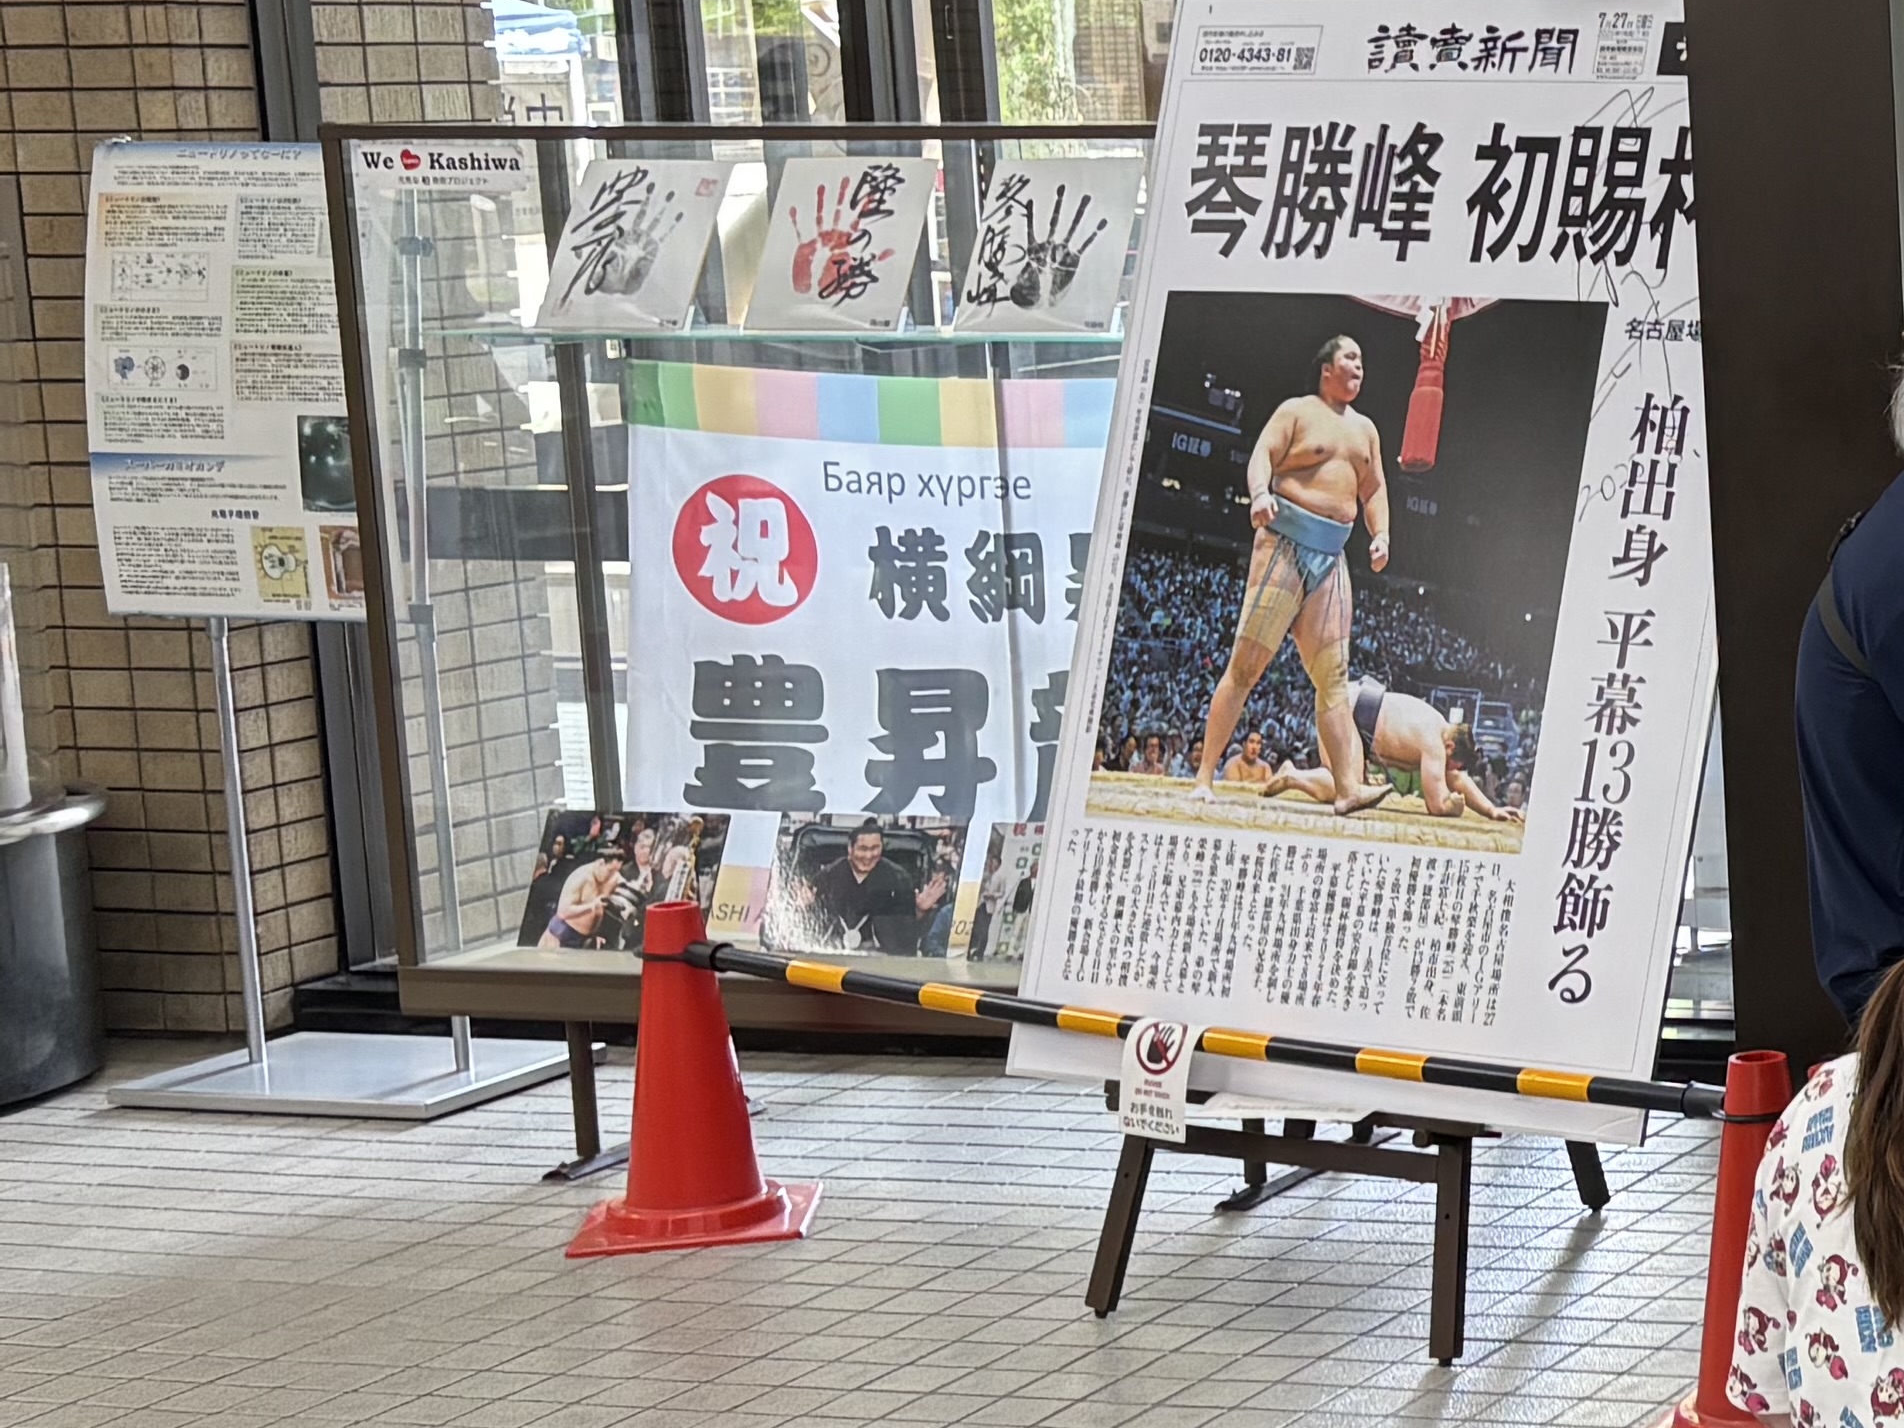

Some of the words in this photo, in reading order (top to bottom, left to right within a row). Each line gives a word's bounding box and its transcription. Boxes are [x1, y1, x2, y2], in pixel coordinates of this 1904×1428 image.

[1367, 24, 1579, 74] 讀賣新聞
[361, 152, 394, 171] We
[428, 152, 521, 171] Kashiwa
[1184, 121, 1446, 263] 琴勝峰
[823, 461, 905, 503] Баяр
[918, 469, 1031, 509] хүргэе
[1606, 393, 1692, 587] 柏出身
[699, 490, 799, 607] 祝
[1548, 609, 1654, 1005] 平幕13勝飾る
